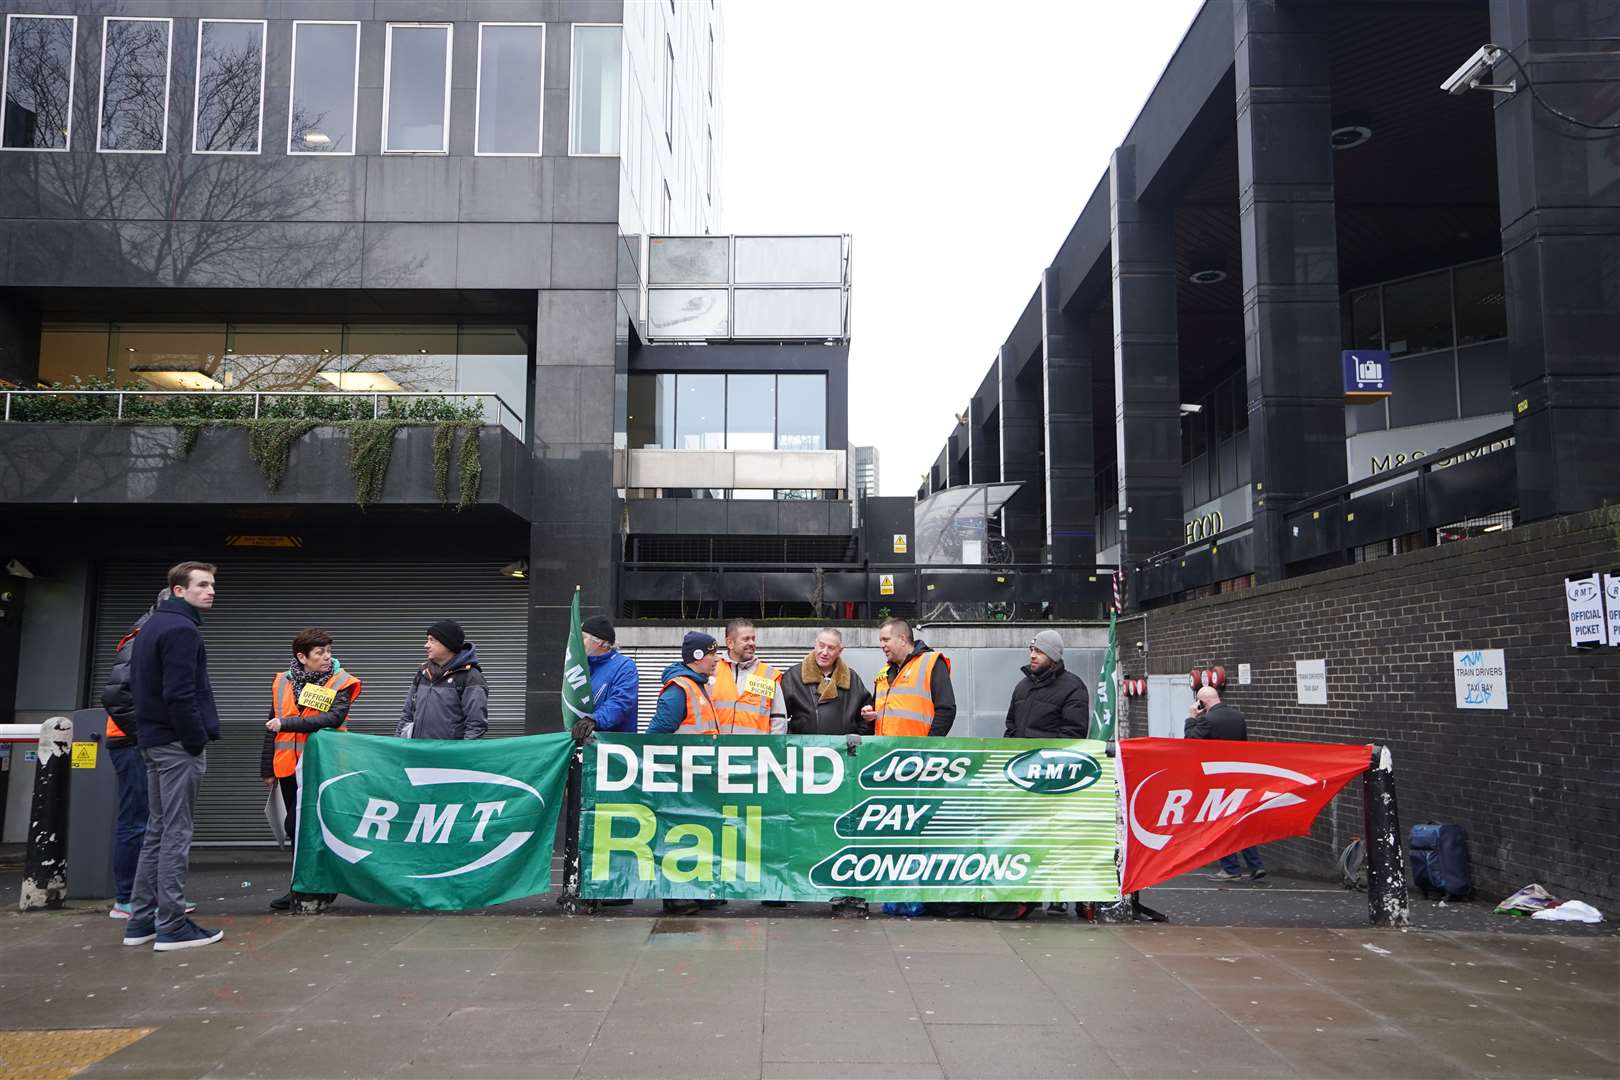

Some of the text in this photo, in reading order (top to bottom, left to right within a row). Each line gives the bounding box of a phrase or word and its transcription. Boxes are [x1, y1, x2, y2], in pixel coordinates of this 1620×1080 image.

[1184, 511, 1223, 545] FOOD
[1574, 586, 1592, 597] RMT
[1571, 609, 1601, 622] OFFICIAL
[1609, 609, 1620, 620] OF
[1575, 624, 1600, 636] PICKET
[1456, 667, 1503, 677] TRAIN DRIVERS
[1467, 683, 1494, 692] TAXI BAY
[303, 691, 333, 705] OFFICIAL
[303, 699, 329, 711] PICKET
[595, 743, 845, 795] DEFEND
[872, 756, 971, 782] JOBS
[1026, 763, 1082, 780] RMT
[352, 797, 507, 844] RMT
[856, 804, 931, 831] PAY
[591, 803, 762, 883] Rail
[830, 853, 1031, 882] CONDITIONS
